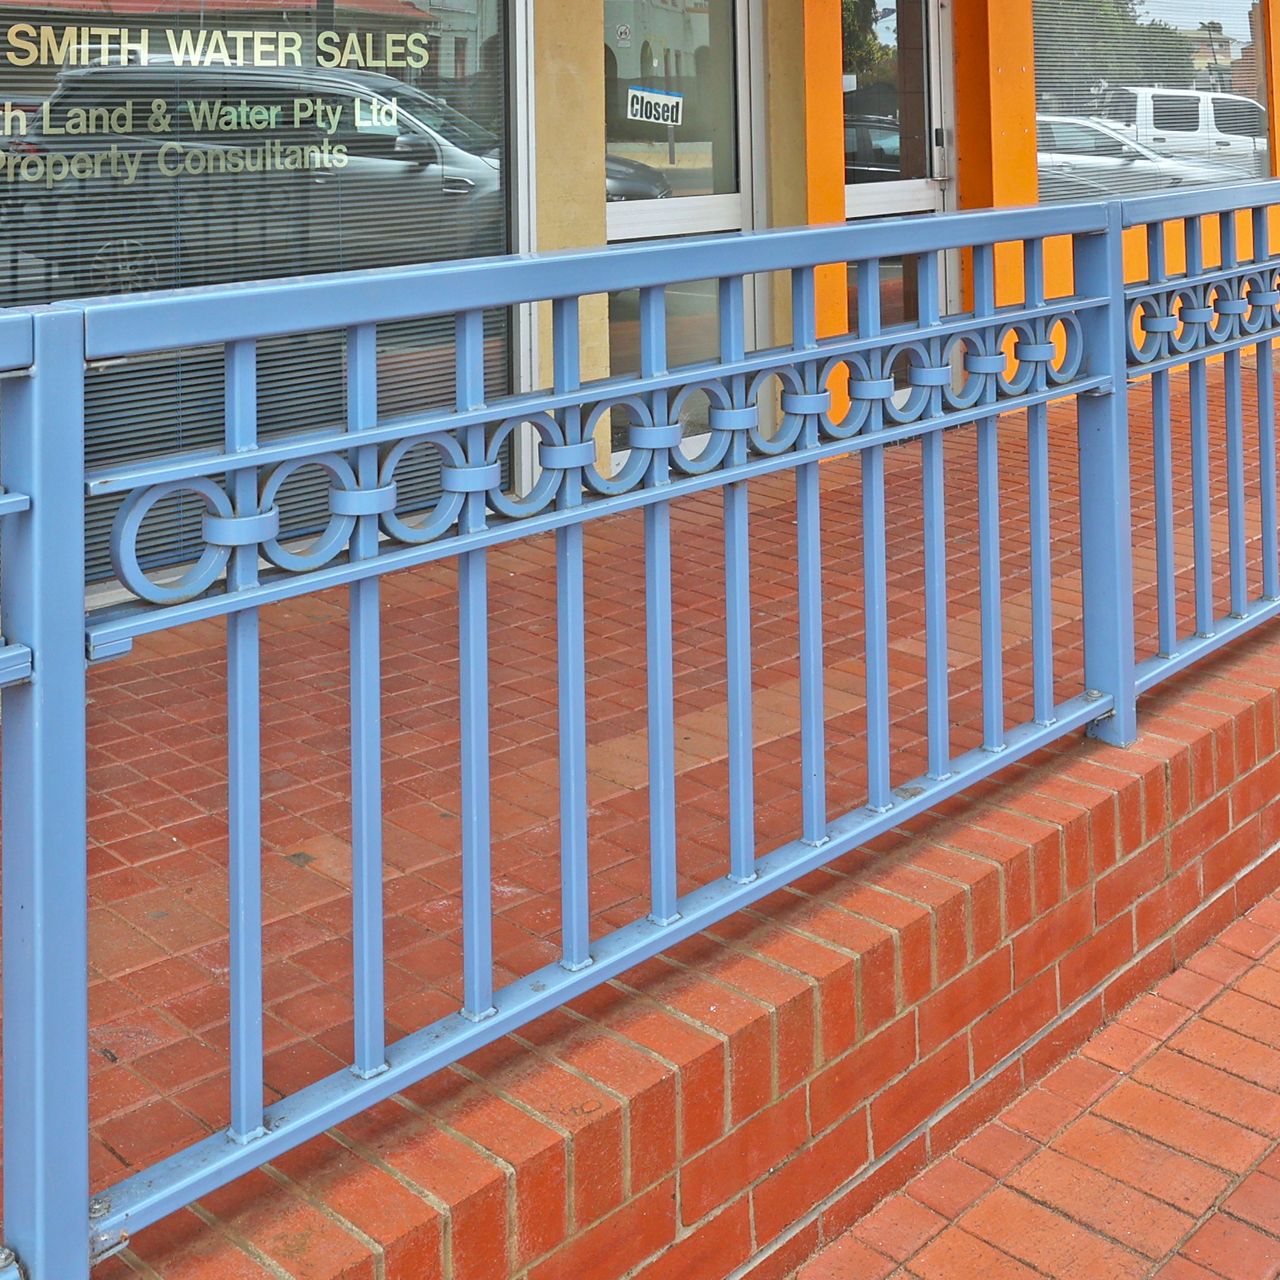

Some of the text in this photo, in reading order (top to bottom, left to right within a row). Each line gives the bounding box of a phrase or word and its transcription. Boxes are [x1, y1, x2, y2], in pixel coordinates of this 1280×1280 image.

[6, 23, 149, 67] SMITH
[166, 28, 303, 67] WATER
[316, 31, 430, 69] SALES
[42, 100, 133, 135] Land
[147, 98, 172, 133] &
[186, 98, 282, 132] Water
[293, 97, 343, 135] Pty
[354, 96, 398, 127] Ltd
[630, 93, 680, 124] Closed
[157, 137, 349, 177] Consultants
